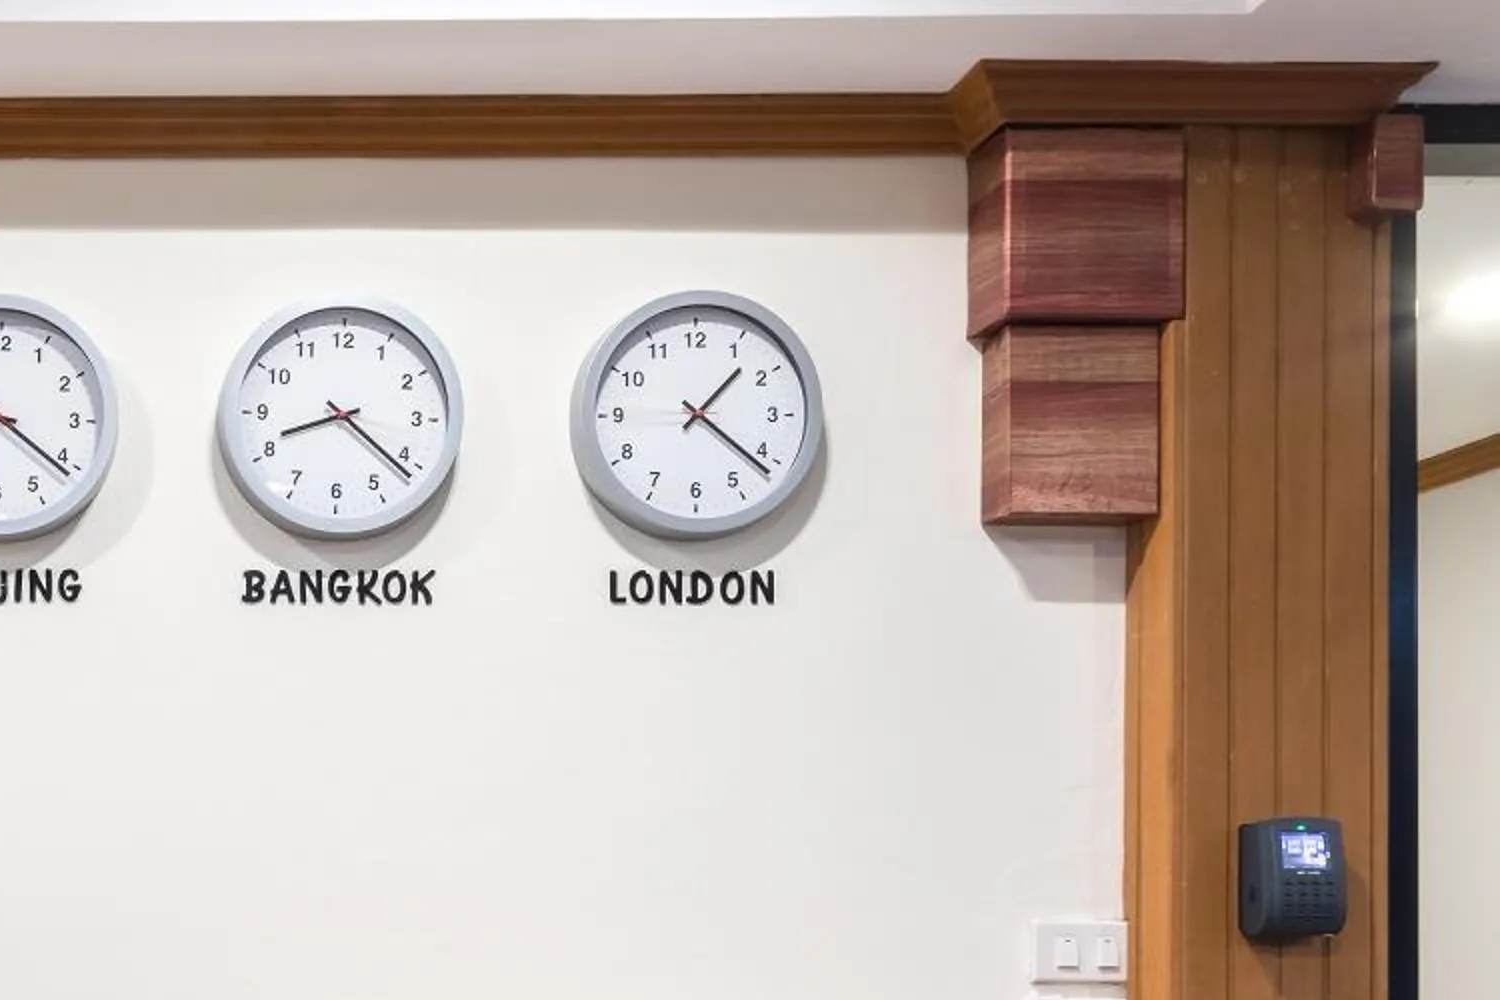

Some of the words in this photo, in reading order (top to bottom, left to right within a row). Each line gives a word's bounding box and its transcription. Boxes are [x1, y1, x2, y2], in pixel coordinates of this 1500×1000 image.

[331, 330, 355, 350] 12
[683, 330, 707, 349] 12
[33, 346, 43, 365] 1
[294, 340, 316, 359] 11
[375, 344, 385, 361] 1
[646, 342, 668, 360] 11
[728, 341, 738, 360] 1
[58, 375, 72, 394] 2
[267, 367, 292, 386] 10
[400, 372, 414, 392] 2
[621, 369, 645, 388] 10
[755, 369, 768, 388] 2
[68, 411, 81, 430] 3
[256, 403, 270, 422] 9
[410, 409, 423, 428] 3
[611, 406, 625, 425] 9
[766, 405, 780, 424] 3
[56, 447, 69, 465] 4
[263, 439, 276, 458] 8
[397, 445, 411, 463] 4
[620, 442, 634, 461] 8
[755, 441, 769, 459] 4
[27, 475, 40, 493] 5
[290, 469, 303, 486] 7
[367, 473, 380, 492] 5
[648, 470, 661, 488] 7
[726, 470, 740, 490] 5
[330, 482, 343, 500] 6
[689, 481, 703, 500] 6
[240, 568, 437, 606] BANGKOK
[608, 568, 776, 606] LONDON
